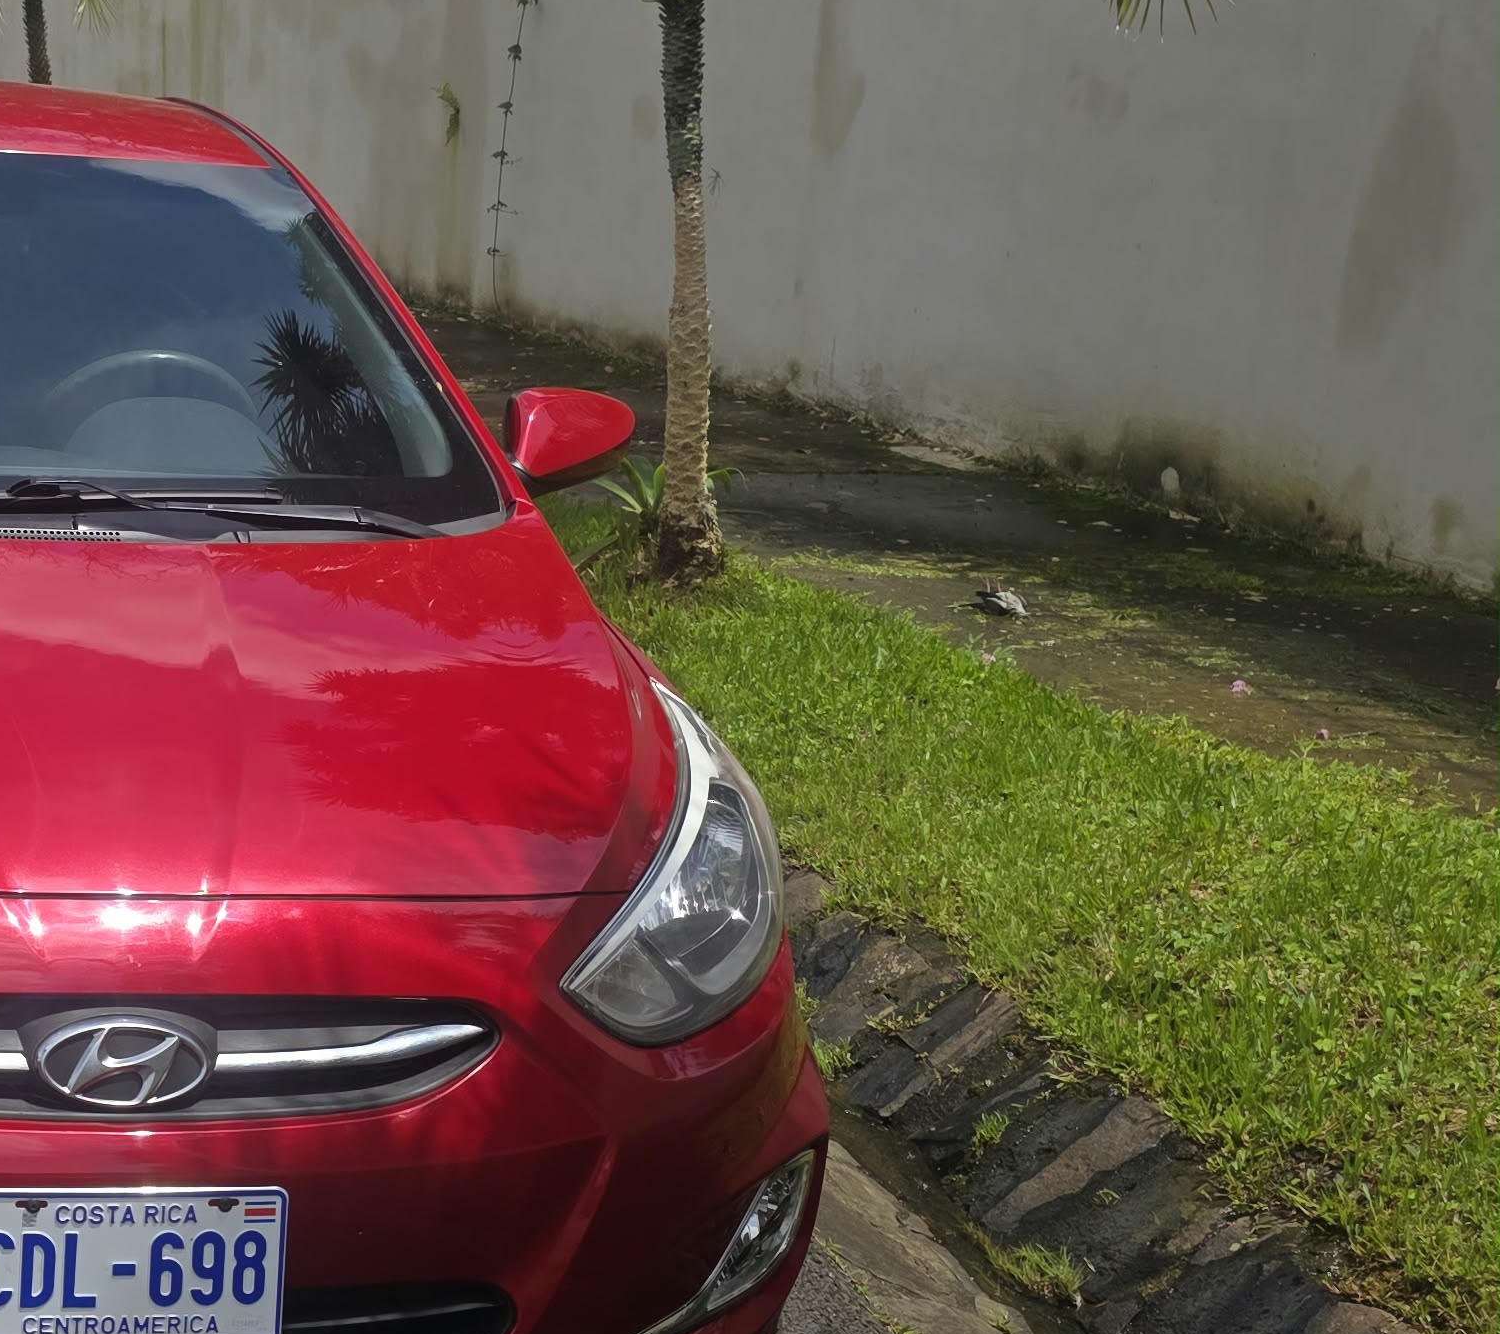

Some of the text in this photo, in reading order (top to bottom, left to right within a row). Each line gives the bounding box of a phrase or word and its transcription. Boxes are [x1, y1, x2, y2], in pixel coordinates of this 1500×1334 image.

[55, 1205, 197, 1224] COSTA RICA
[22, 1315, 218, 1334] CENTROAMERICA
